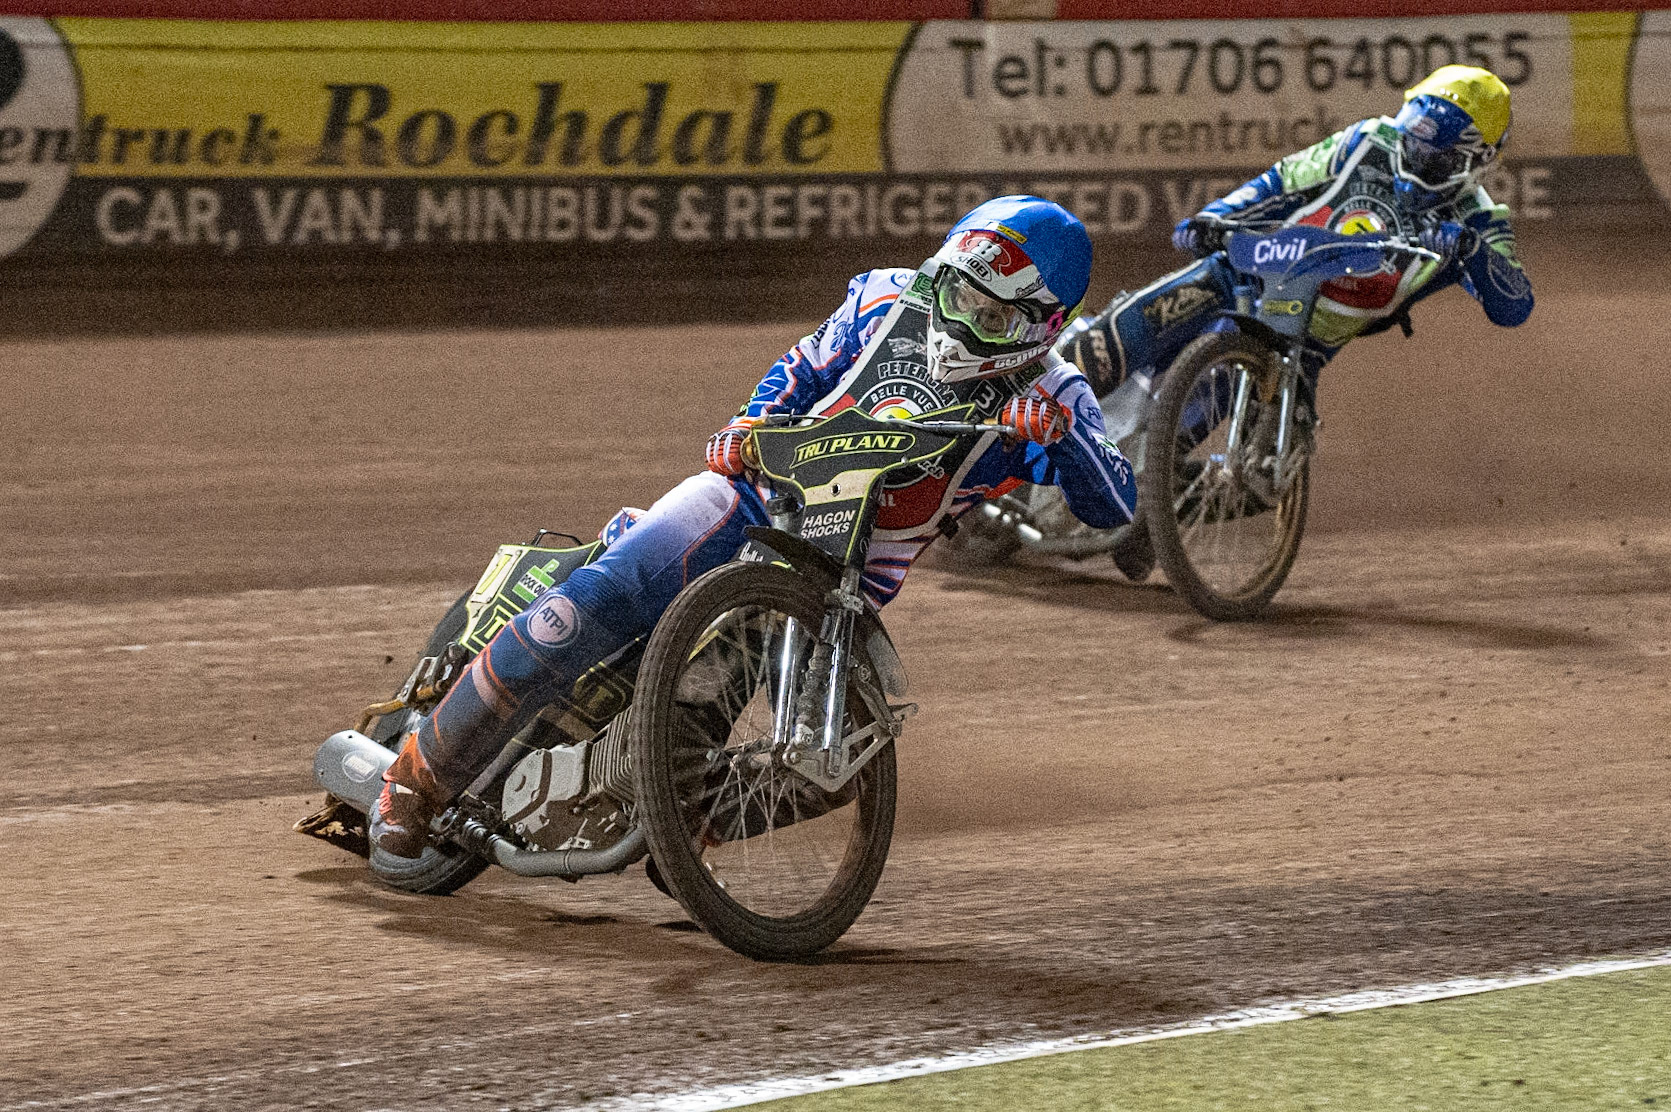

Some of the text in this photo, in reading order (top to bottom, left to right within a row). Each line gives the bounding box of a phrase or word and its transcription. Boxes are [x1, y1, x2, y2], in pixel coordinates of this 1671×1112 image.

[1086, 37, 1285, 98] 01706
[309, 81, 834, 169] Rochdale
[96, 185, 240, 253] CAR,
[253, 186, 401, 249] VAN,
[412, 185, 662, 243] MINIBUS
[671, 183, 711, 241] &
[1254, 238, 1307, 264] Civil
[956, 255, 989, 279] SHOEI
[871, 385, 935, 412] BELLE VUE
[797, 435, 906, 461] TRU PLANT
[800, 522, 850, 539] SHOCKS
[803, 510, 856, 528] HAGON
[539, 606, 568, 636] ATPI
